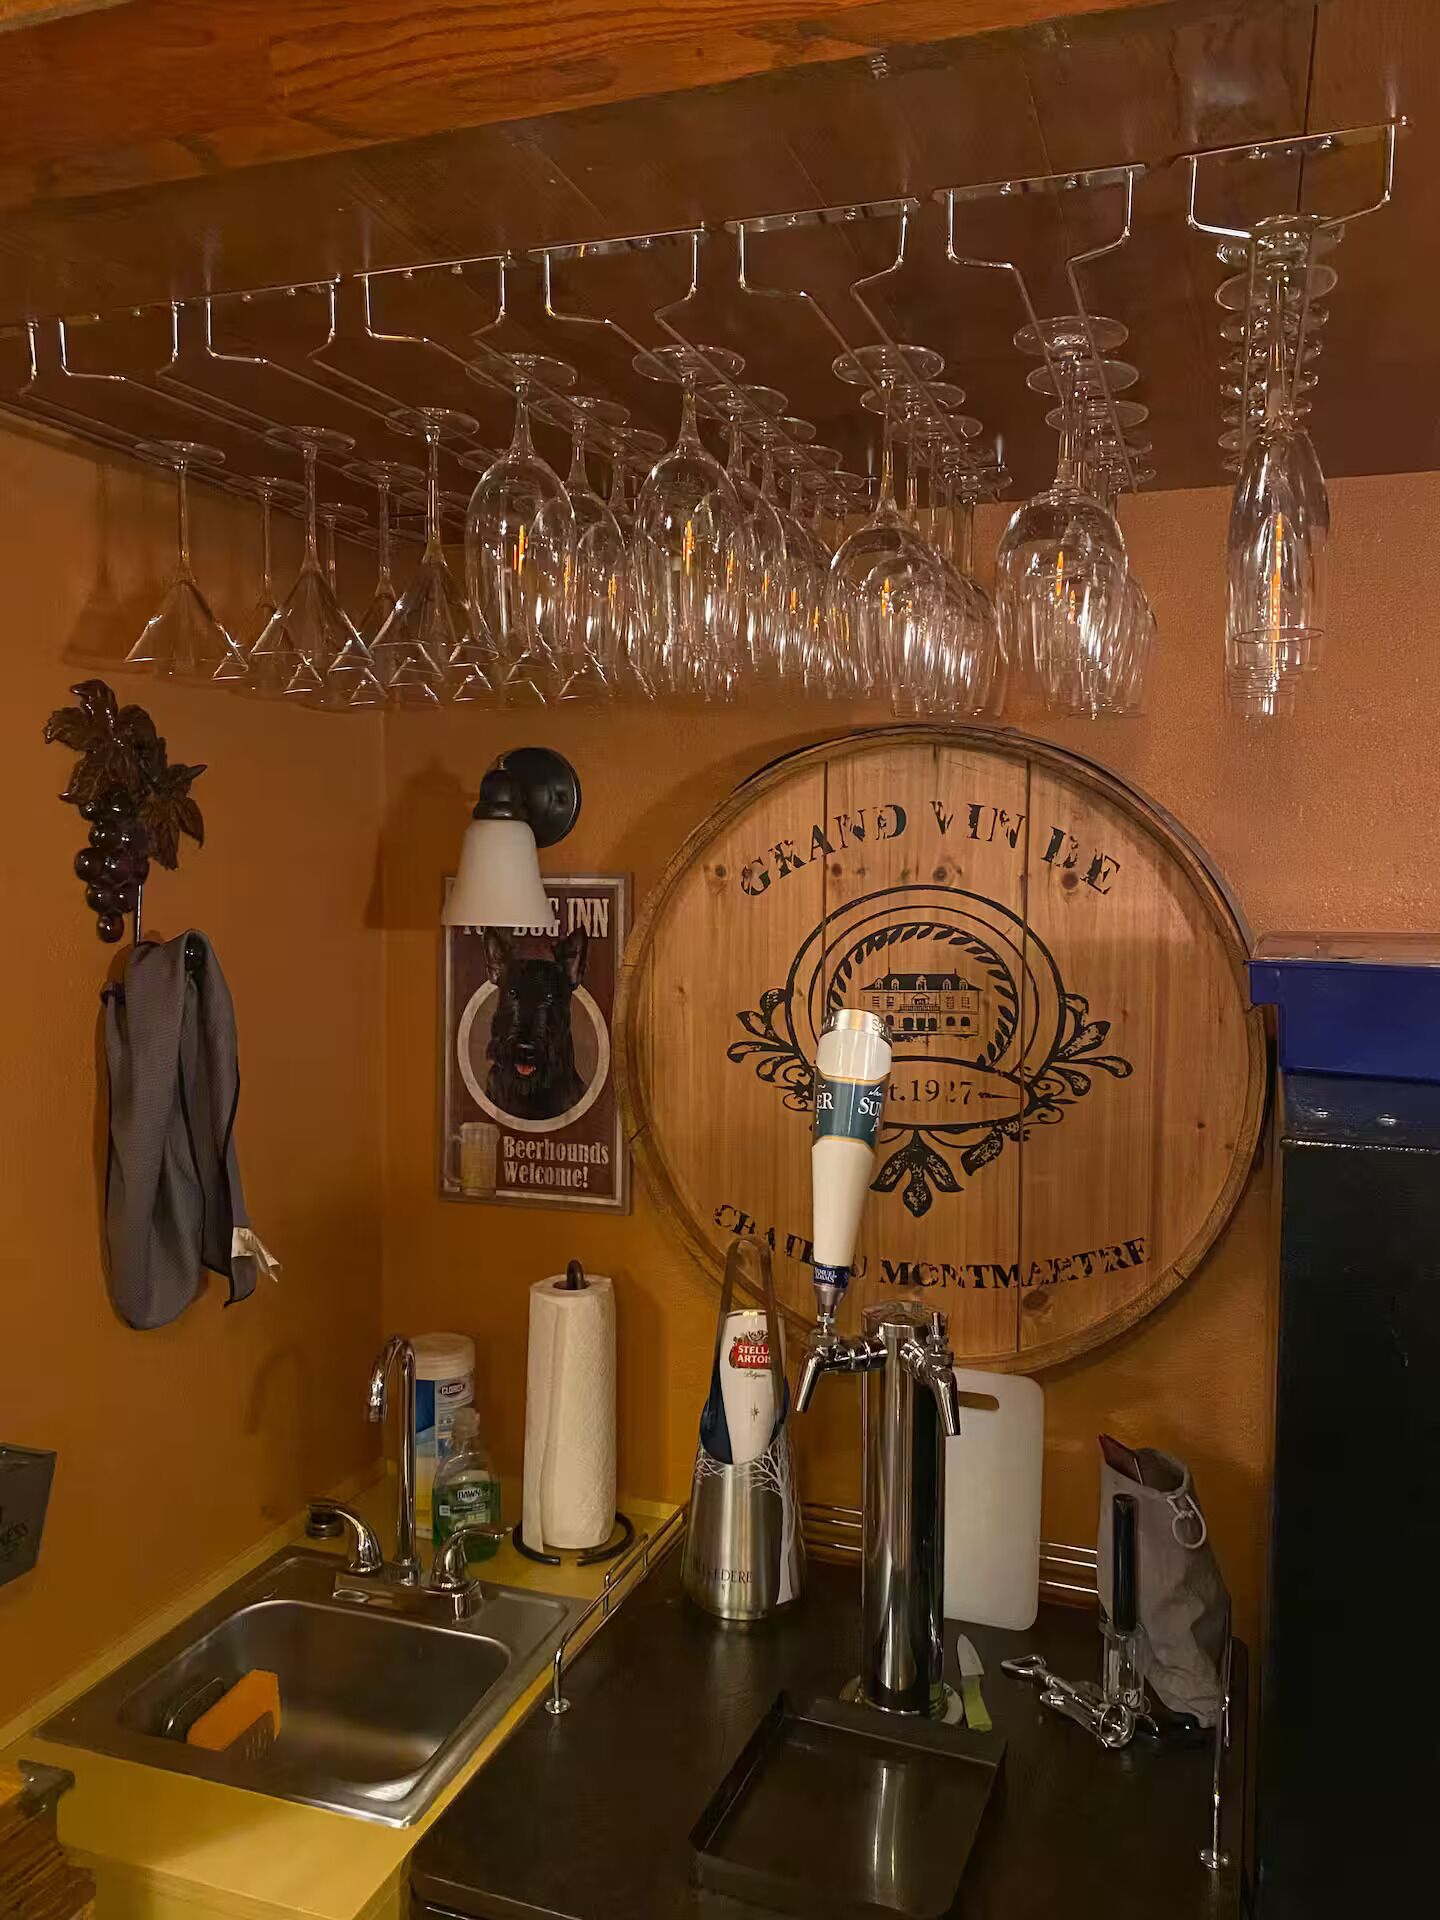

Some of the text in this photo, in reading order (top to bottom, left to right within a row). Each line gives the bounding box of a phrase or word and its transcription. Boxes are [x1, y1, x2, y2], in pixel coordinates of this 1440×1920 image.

[740, 800, 1121, 897] GRAND VIN DE
[566, 897, 610, 938] INN
[816, 1091, 834, 1110] ER
[888, 1079, 973, 1104] t.1927
[858, 1096, 881, 1117] SU
[503, 1135, 609, 1164] Beerhounds
[503, 1160, 588, 1188] Welcome!
[712, 1203, 1152, 1289] CHATU MONTMARTRE
